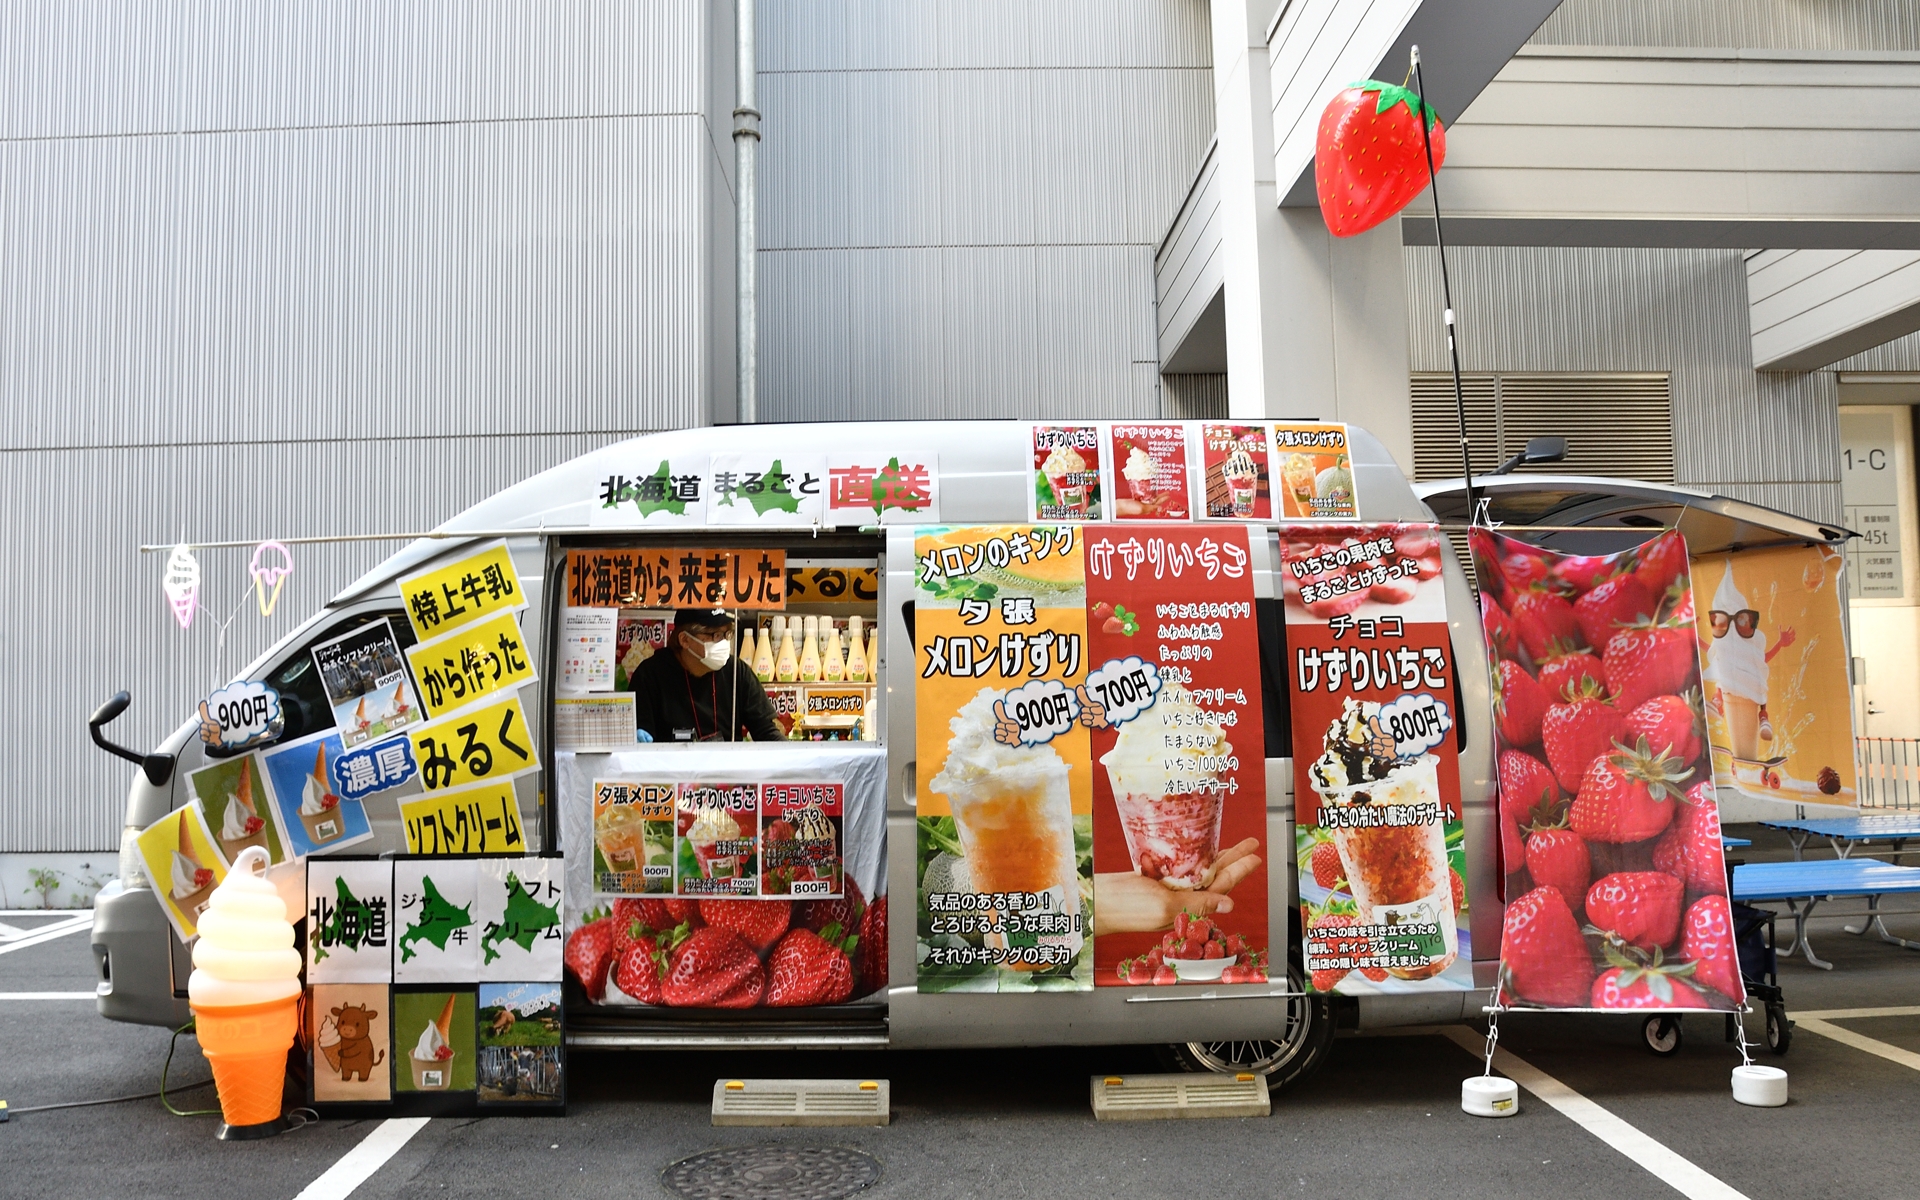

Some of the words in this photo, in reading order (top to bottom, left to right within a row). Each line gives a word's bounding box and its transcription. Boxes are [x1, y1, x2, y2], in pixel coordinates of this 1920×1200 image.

[1036, 431, 1097, 449] けずりいちご
[1205, 428, 1232, 438] チョコ
[1276, 430, 1345, 448] 夕張メロンけずり
[1209, 440, 1267, 452] けずりいちご
[1843, 449, 1886, 471] 1-C
[600, 474, 702, 504] 北海道
[714, 472, 821, 496] まるごと
[829, 464, 932, 510] 直送
[1864, 530, 1889, 545] 45t
[920, 526, 1075, 583] メロンのキング
[1090, 537, 1248, 582] けずりいちご
[1291, 537, 1396, 579] いちごの果肉を
[572, 552, 781, 607] 北海道から来ました
[1300, 557, 1419, 604] まるごとけずった
[410, 562, 514, 631] 特上牛乳
[960, 598, 1037, 626] 夕張
[1158, 622, 1223, 640] ふわふわ触感
[1330, 614, 1404, 640] チョコ
[322, 636, 392, 672] みるくソフトクリーム
[923, 629, 1081, 679] メロンけずり
[1159, 644, 1213, 661] たっぷりの
[378, 672, 402, 687] 900円
[423, 633, 526, 708] から作った
[1161, 666, 1193, 683] 練乳と
[1298, 647, 1446, 692] けずりいちご
[1096, 668, 1153, 713] 700円
[1162, 688, 1247, 705] ホイップクリーム
[218, 694, 269, 732] 900円
[808, 695, 863, 711] 夕張メロンけずり
[1015, 692, 1073, 731] 900円
[1162, 710, 1238, 726] いちご好きには
[1390, 704, 1443, 744] 800円
[419, 708, 529, 790] みるく
[1164, 734, 1216, 748] たまらない
[341, 743, 411, 793] 濃厚
[598, 786, 674, 805] 夕張メロン
[766, 786, 835, 805] チョコいちご
[1165, 777, 1239, 795] 冷たいデザート
[682, 789, 756, 810] けずりいちご
[642, 805, 672, 816] けずり
[782, 808, 820, 822] けずり
[1317, 803, 1456, 829] いちごの冷たい魔法のデザート
[407, 796, 522, 855] ソフトクリーム
[644, 867, 669, 876] 900円
[504, 880, 562, 899] ソフト
[794, 883, 828, 893] 800円
[401, 893, 432, 910] ジャ
[929, 892, 1051, 912] 気品のある香り！
[311, 896, 387, 948] 北海道
[483, 920, 562, 941] クリーム
[929, 914, 1082, 934] とろけるような果肉！
[1307, 924, 1438, 939] いちごの味を引き立てるため
[452, 929, 469, 946] 牛
[1308, 940, 1419, 955] 練乳、ホイップクリーム
[929, 945, 1072, 967] それがキングの実力
[1309, 956, 1430, 970] 当店の隠し味で整えました
